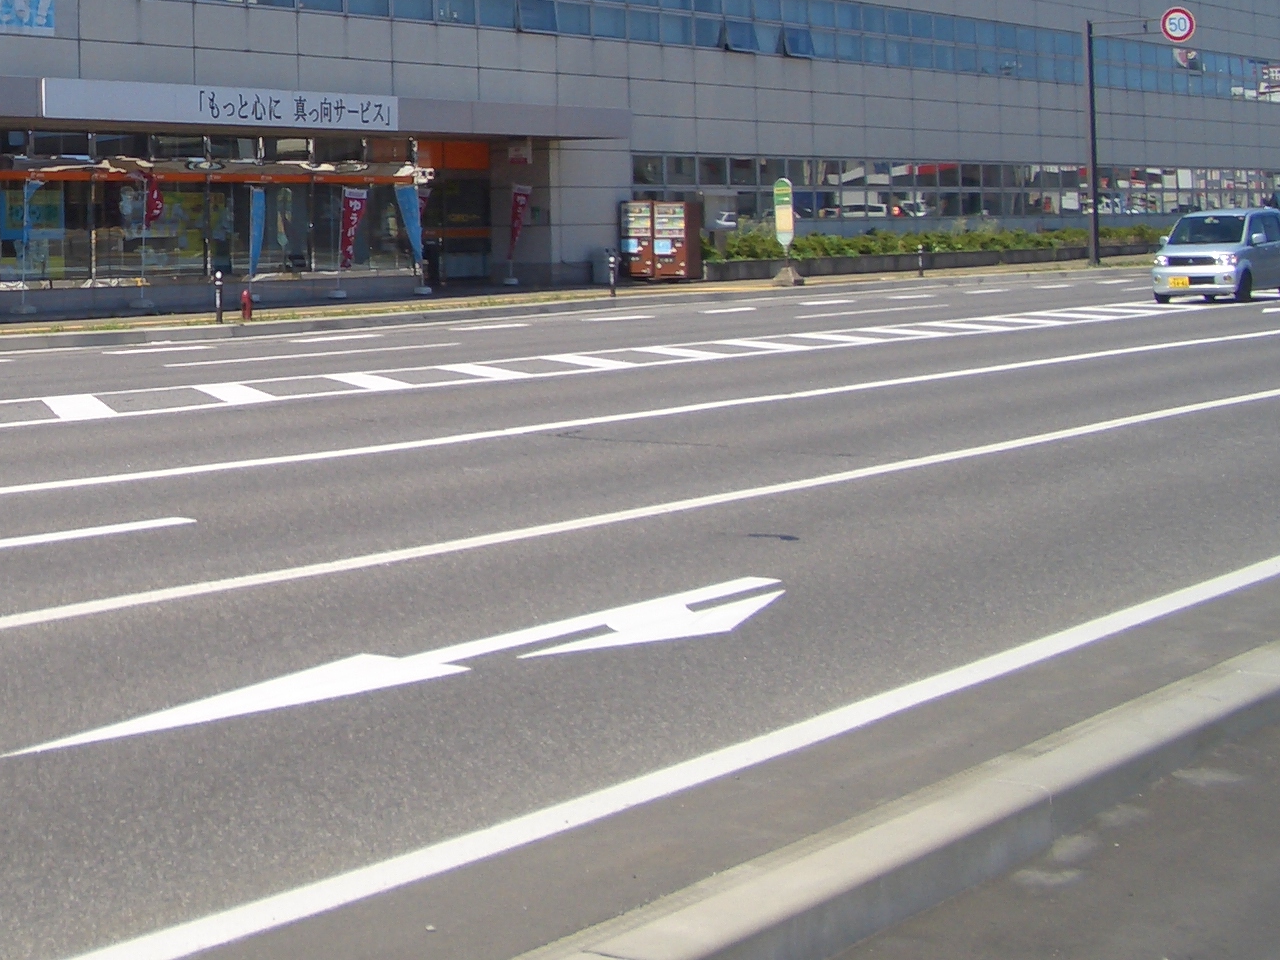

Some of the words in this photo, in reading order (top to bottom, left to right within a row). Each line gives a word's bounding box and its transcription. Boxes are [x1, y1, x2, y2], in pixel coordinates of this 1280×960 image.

[1168, 17, 1187, 32] 50
[199, 90, 283, 121] 「もっと心に
[293, 95, 391, 127] 真っ向サービス」
